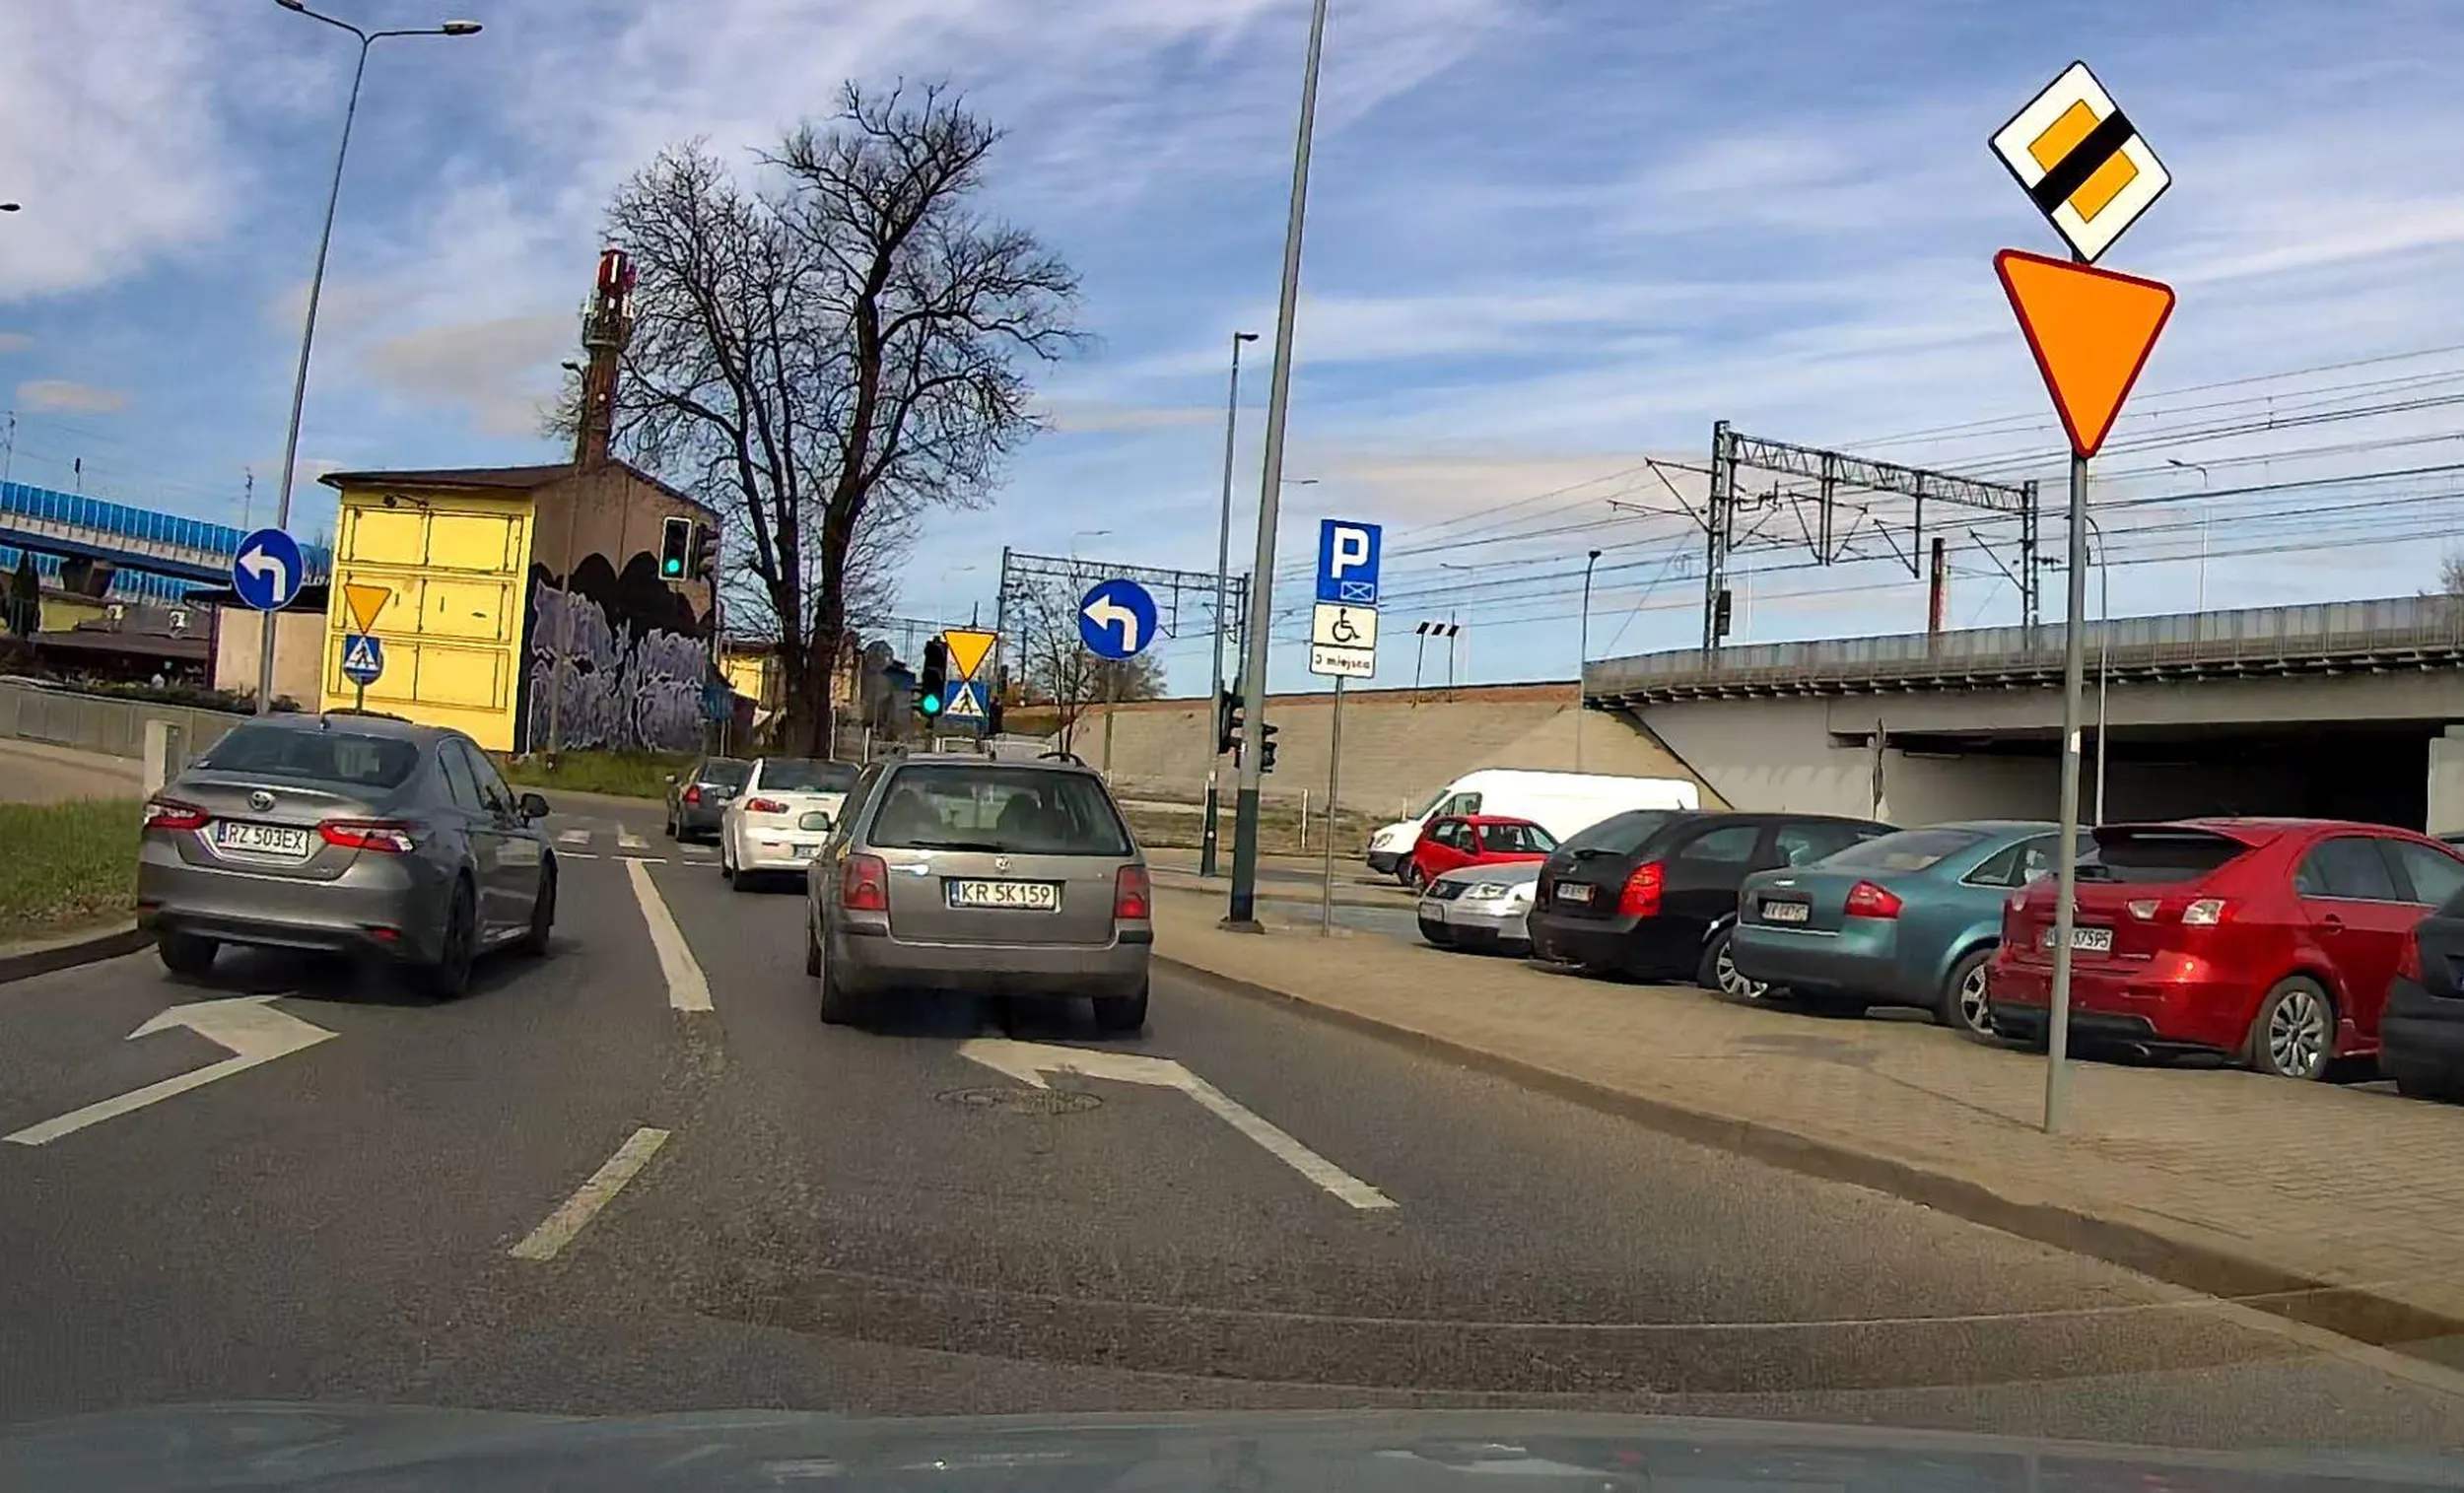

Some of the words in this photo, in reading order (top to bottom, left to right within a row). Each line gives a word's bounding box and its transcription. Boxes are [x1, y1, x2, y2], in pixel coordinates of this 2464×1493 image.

[1332, 526, 1369, 578] P
[1326, 654, 1370, 671] miejsca
[229, 825, 249, 844] RZ
[253, 828, 304, 849] 503EX
[962, 883, 989, 901] KR
[995, 885, 1051, 903] 5K159
